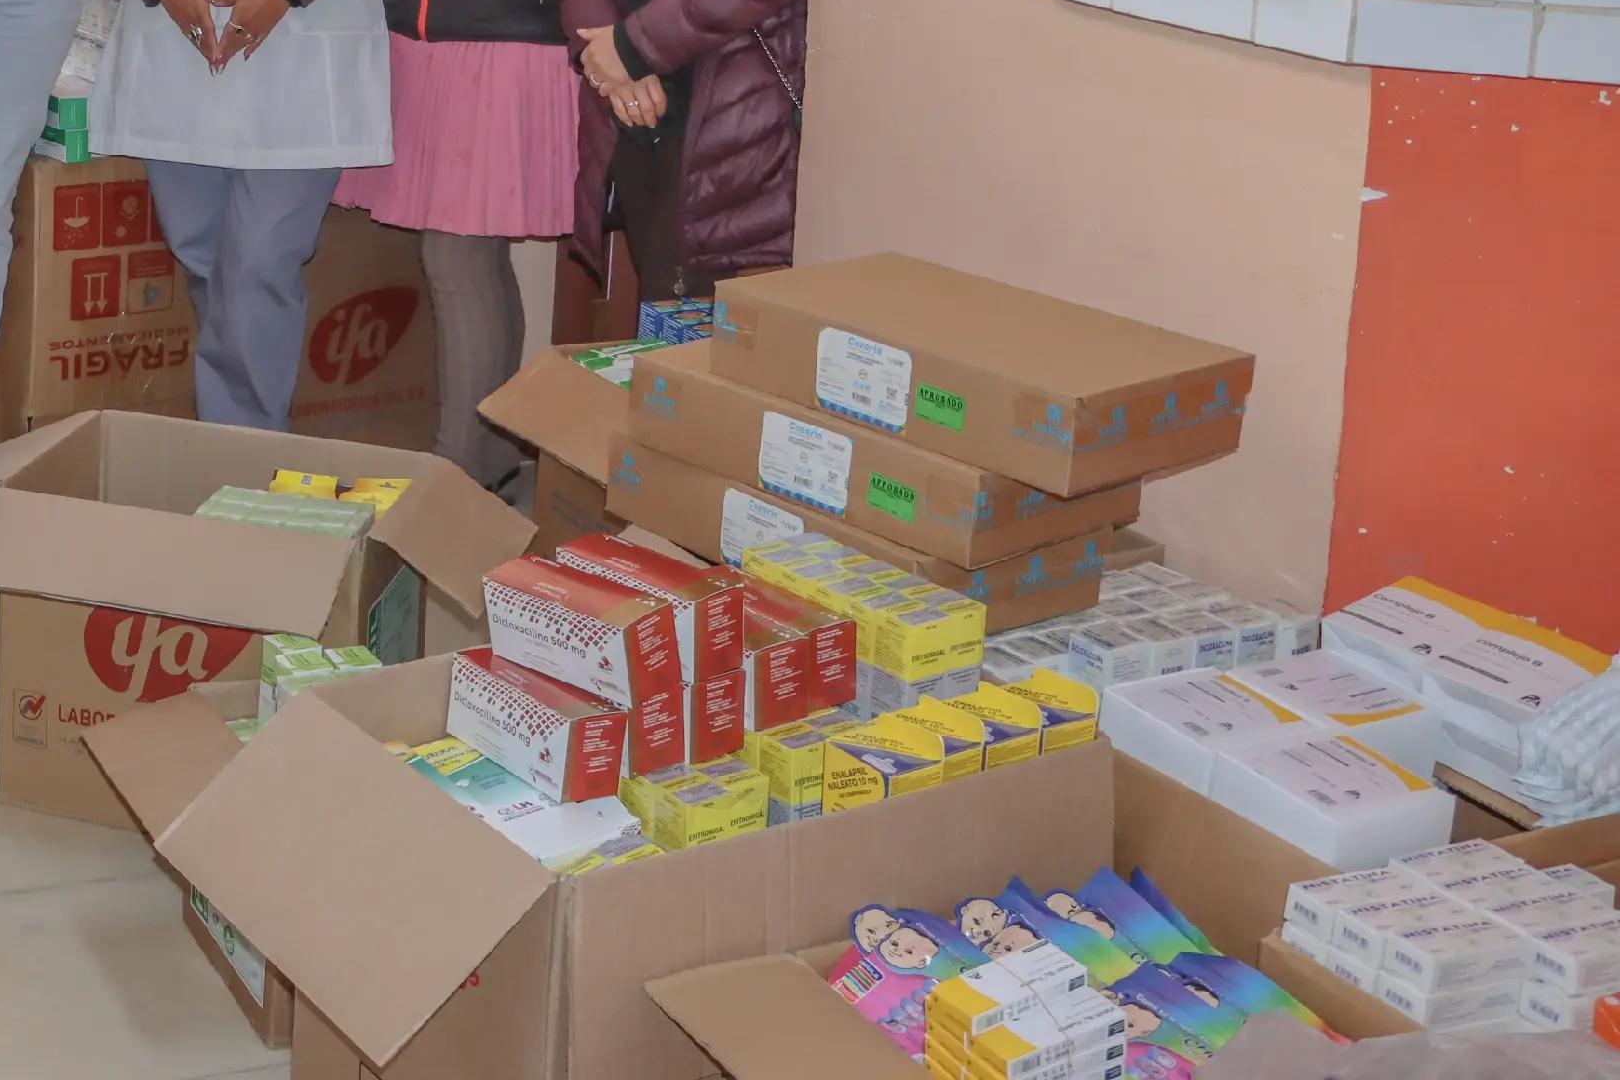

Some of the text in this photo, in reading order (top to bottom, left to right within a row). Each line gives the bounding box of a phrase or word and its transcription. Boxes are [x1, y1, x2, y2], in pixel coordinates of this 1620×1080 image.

[918, 387, 963, 410] APROBADO
[789, 421, 823, 440] Cozarin
[870, 476, 915, 501] APROBADO
[1372, 593, 1424, 616] Complejo
[550, 636, 569, 651] 500
[571, 644, 587, 659] mg
[58, 703, 116, 727] LABO
[502, 721, 517, 736] 500
[518, 731, 531, 748] mg
[828, 777, 879, 791] MALEATO 10 mg
[831, 767, 868, 779] ENALAPRIL
[1401, 841, 1484, 864] NISTATINA
[1301, 870, 1390, 891] NISTATINA
[1443, 867, 1524, 889] NISTATINA
[1351, 894, 1440, 916] NISTATINA
[1402, 919, 1493, 940] NISTATINA
[1541, 919, 1620, 940] NISTATIN
